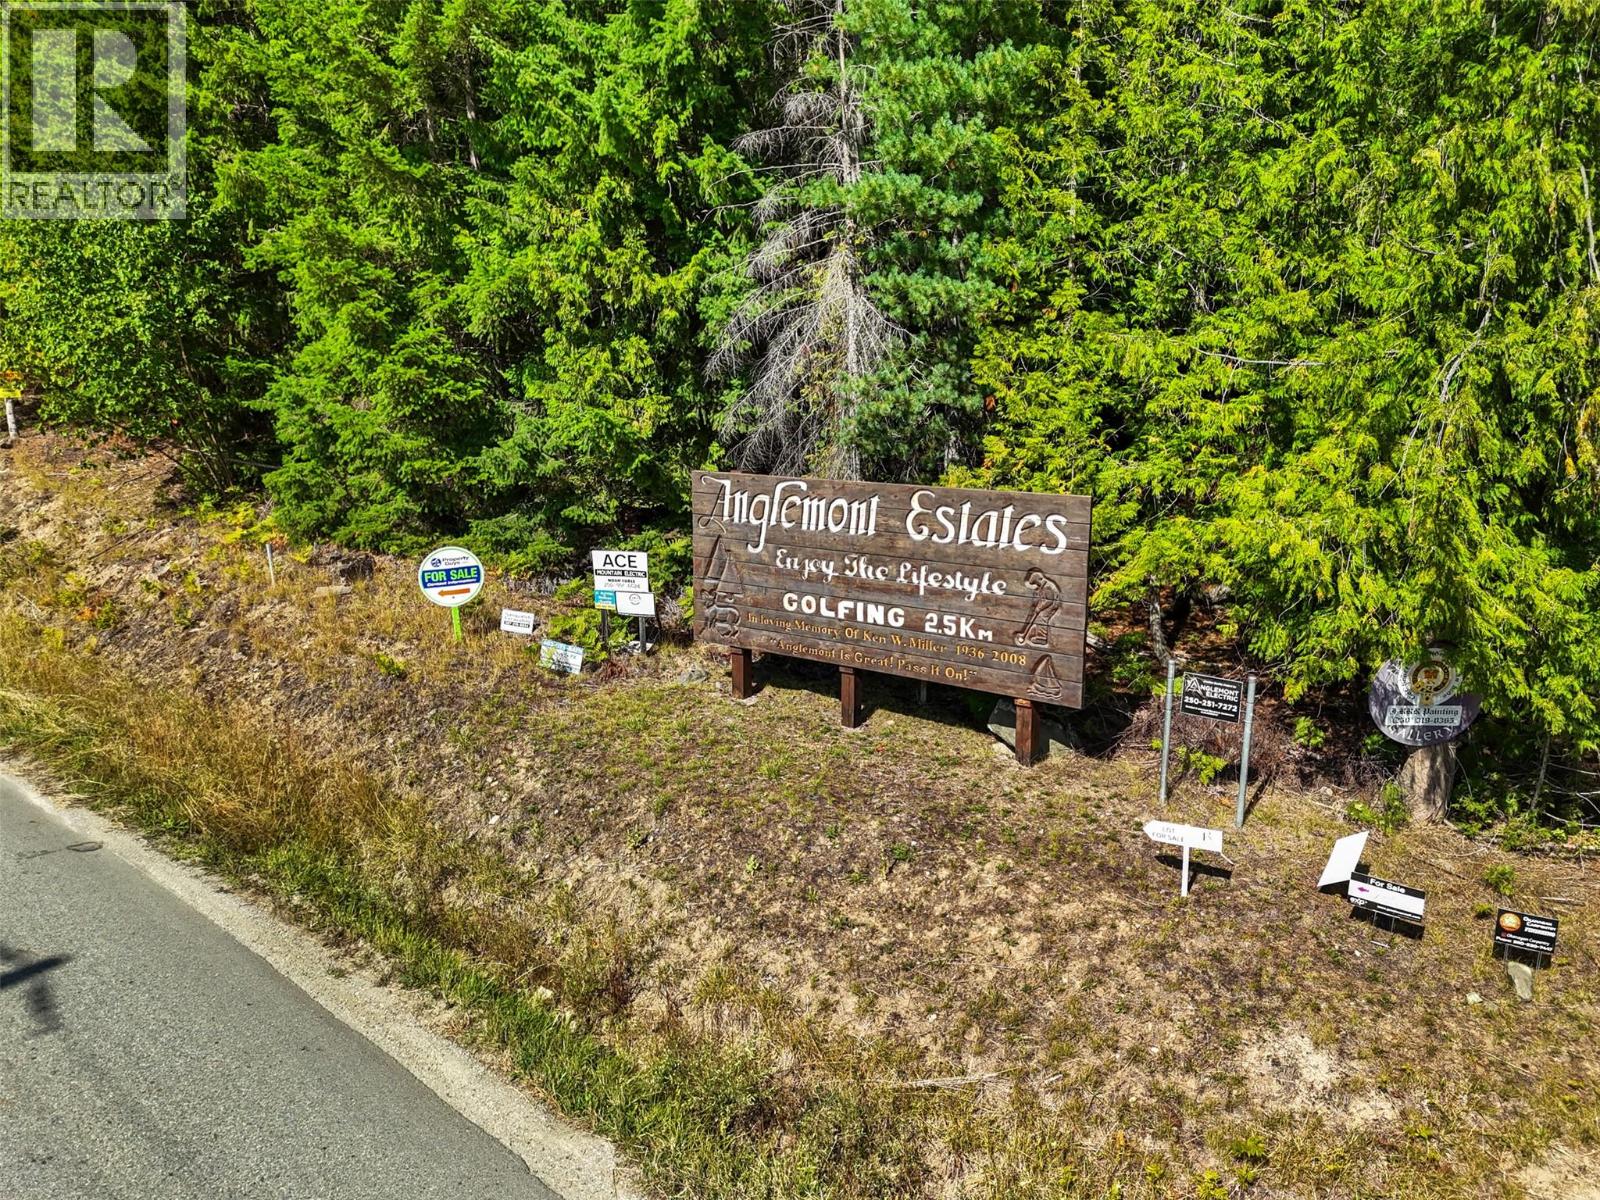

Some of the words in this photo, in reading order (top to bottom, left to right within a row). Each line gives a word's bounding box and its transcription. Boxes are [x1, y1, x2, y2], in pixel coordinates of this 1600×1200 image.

[698, 475, 880, 553] Anglemont
[906, 489, 1068, 555] Estates
[603, 554, 637, 568] ACE
[424, 571, 447, 582] FOR
[450, 567, 478, 580] SALE
[776, 549, 839, 583] Enjoy
[844, 554, 889, 580] The
[896, 562, 1007, 601] Lifestyle
[783, 592, 905, 627] GOLFING
[748, 613, 758, 623] In
[760, 615, 792, 632] loving
[792, 620, 840, 640] Memory
[845, 627, 859, 638] Of
[863, 630, 887, 643] Ken
[909, 637, 948, 653] Miller
[956, 645, 985, 659] 1936
[992, 650, 1026, 666] 2008
[840, 650, 850, 660] Is
[854, 652, 893, 668] Great!
[898, 659, 927, 673] Pass
[931, 664, 940, 676] It
[1184, 696, 1238, 712] 250-251-7272
[1205, 692, 1239, 702] ELECTRIC
[1423, 707, 1459, 716] Painting
[1167, 834, 1184, 842] SALE
[1370, 878, 1384, 887] For
[1386, 882, 1405, 893] Sale
